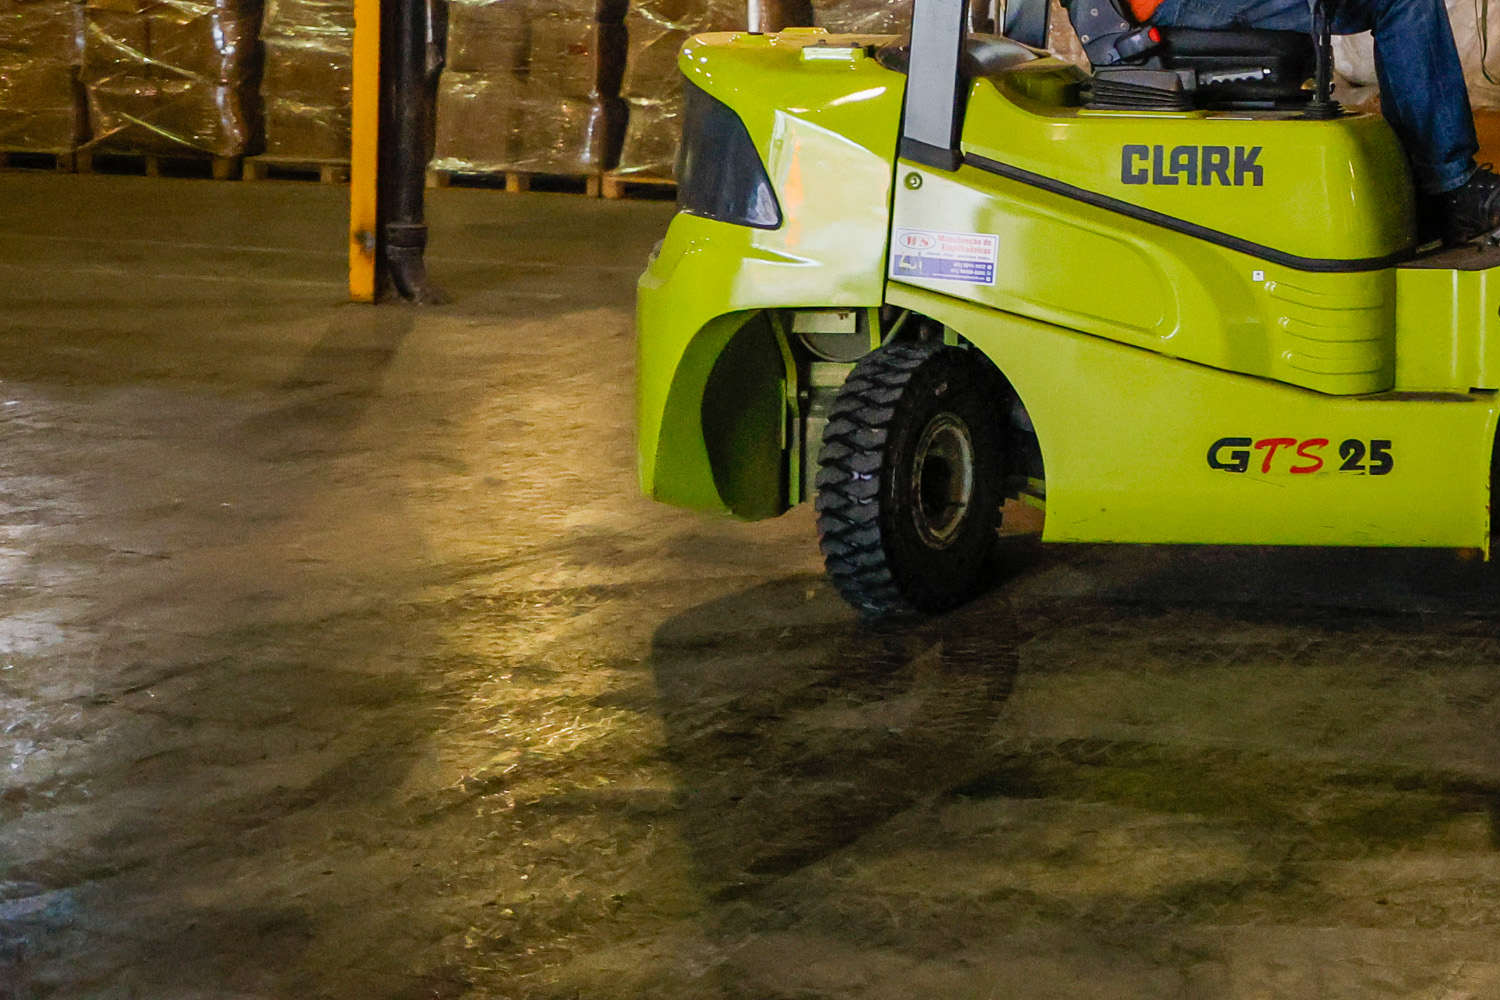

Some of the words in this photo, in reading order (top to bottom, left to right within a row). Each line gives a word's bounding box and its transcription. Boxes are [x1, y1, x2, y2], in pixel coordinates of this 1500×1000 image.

[1121, 144, 1264, 187] CLARK
[1206, 437, 1330, 475] GTS
[1338, 438, 1394, 476] 25
